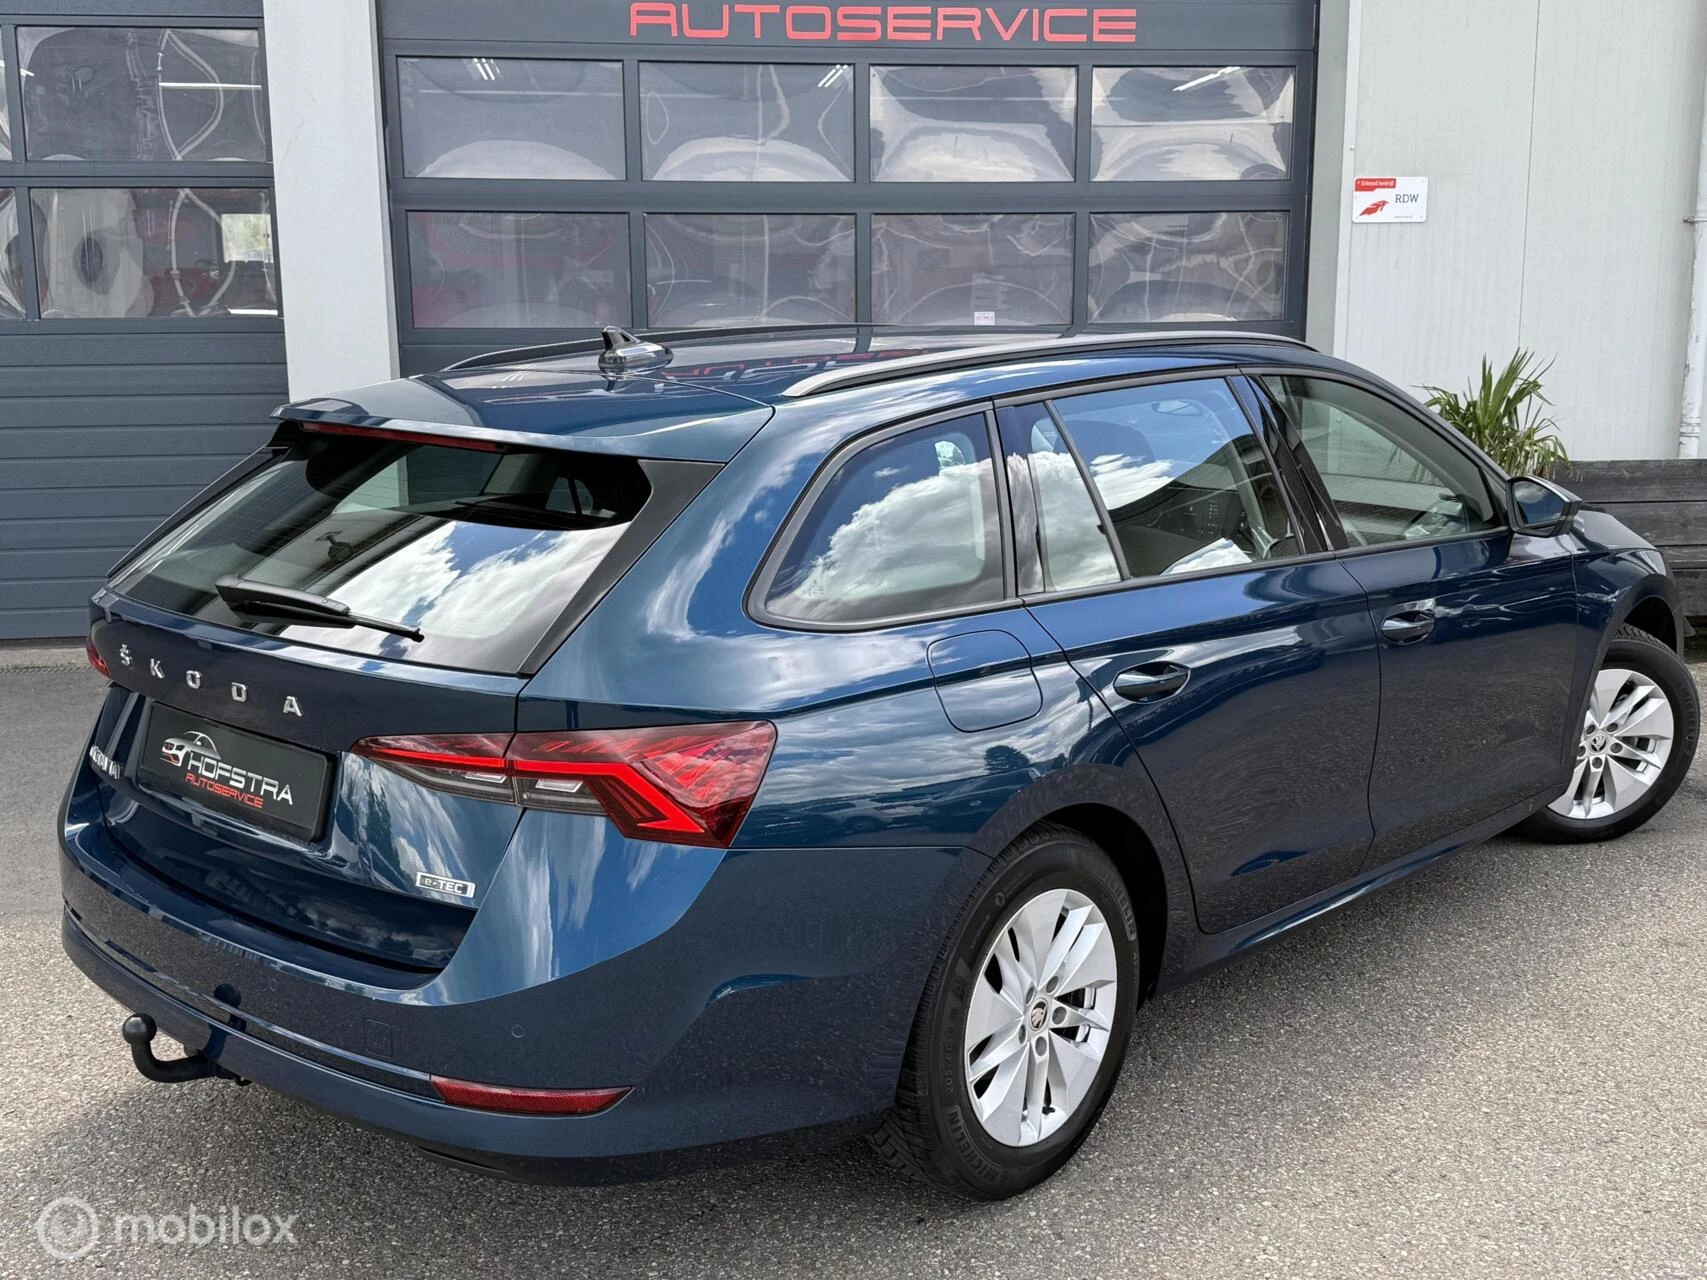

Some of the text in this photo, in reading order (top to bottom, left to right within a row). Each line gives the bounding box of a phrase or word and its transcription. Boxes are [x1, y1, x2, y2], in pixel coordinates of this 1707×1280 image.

[630, 2, 1137, 43] AUTOSERVICE
[1395, 194, 1419, 204] RDW
[185, 772, 265, 809] AUTOSERVICE
[187, 749, 294, 806] HOFSTRA
